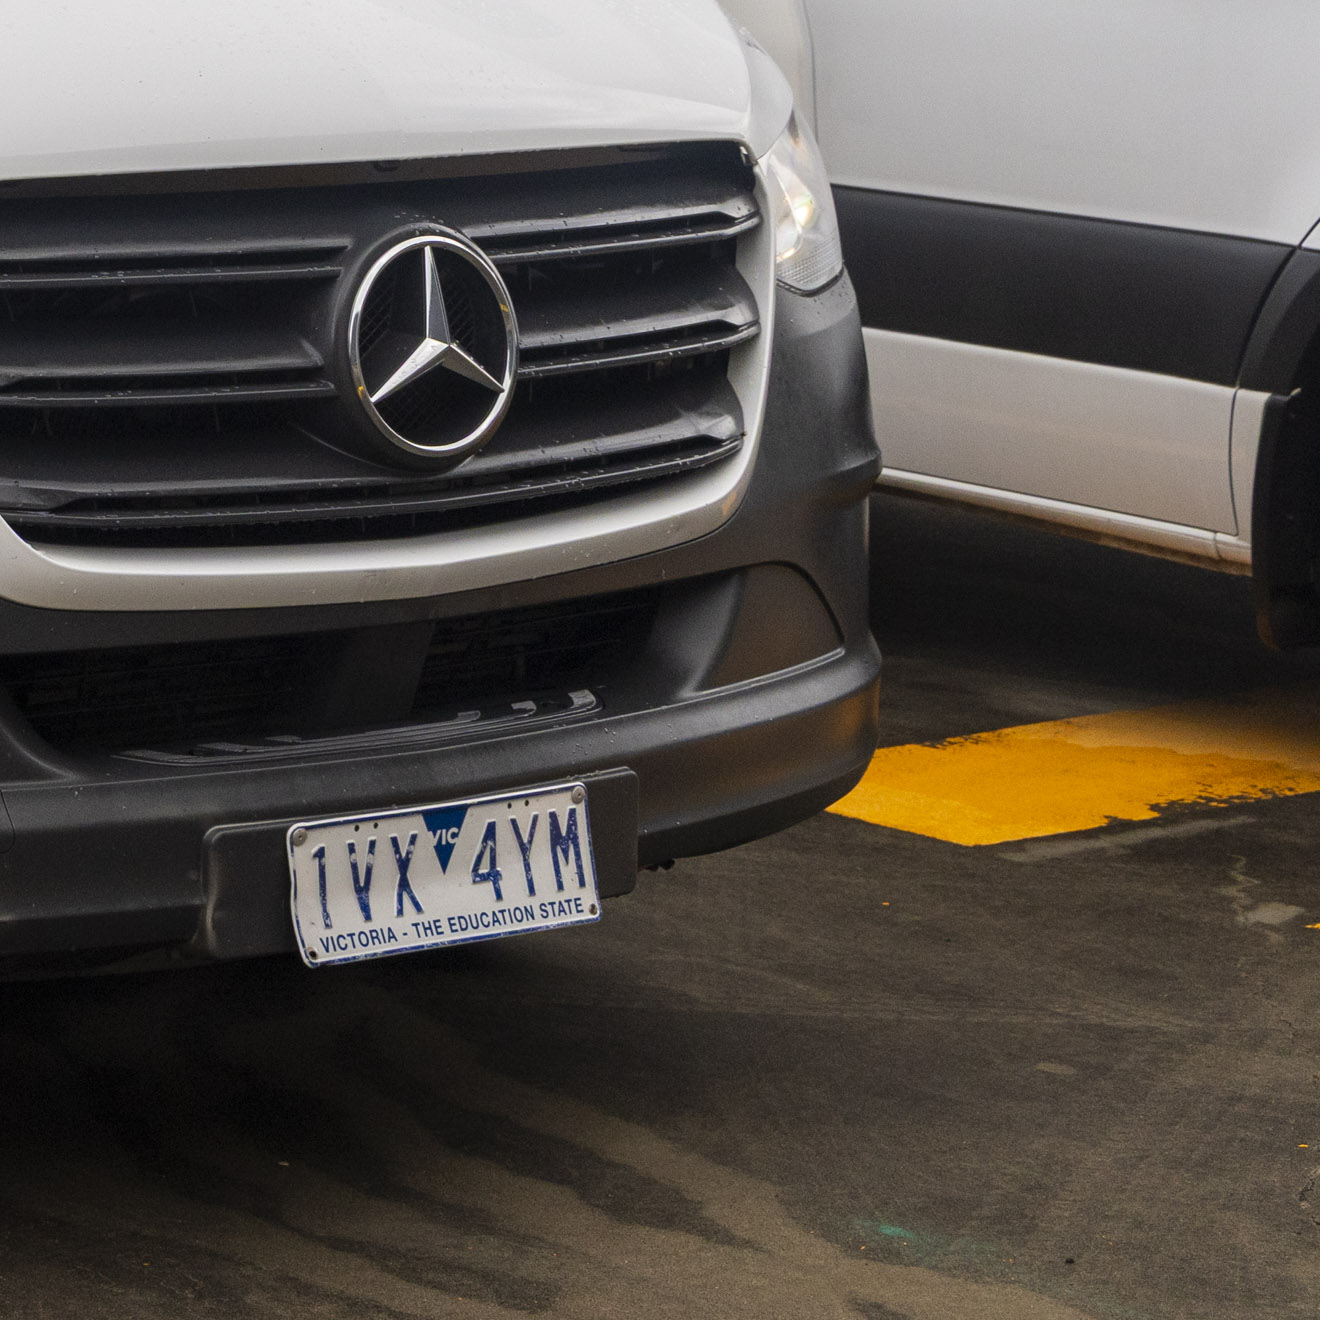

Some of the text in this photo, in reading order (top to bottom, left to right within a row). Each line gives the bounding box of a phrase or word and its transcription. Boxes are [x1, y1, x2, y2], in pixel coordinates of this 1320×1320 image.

[431, 827, 459, 846] VIC
[312, 806, 587, 929] 1VX 4YM
[319, 926, 398, 954] VICTORIA
[411, 918, 445, 939] THE
[449, 907, 536, 932] EDUCATION
[540, 896, 585, 918] STATE
